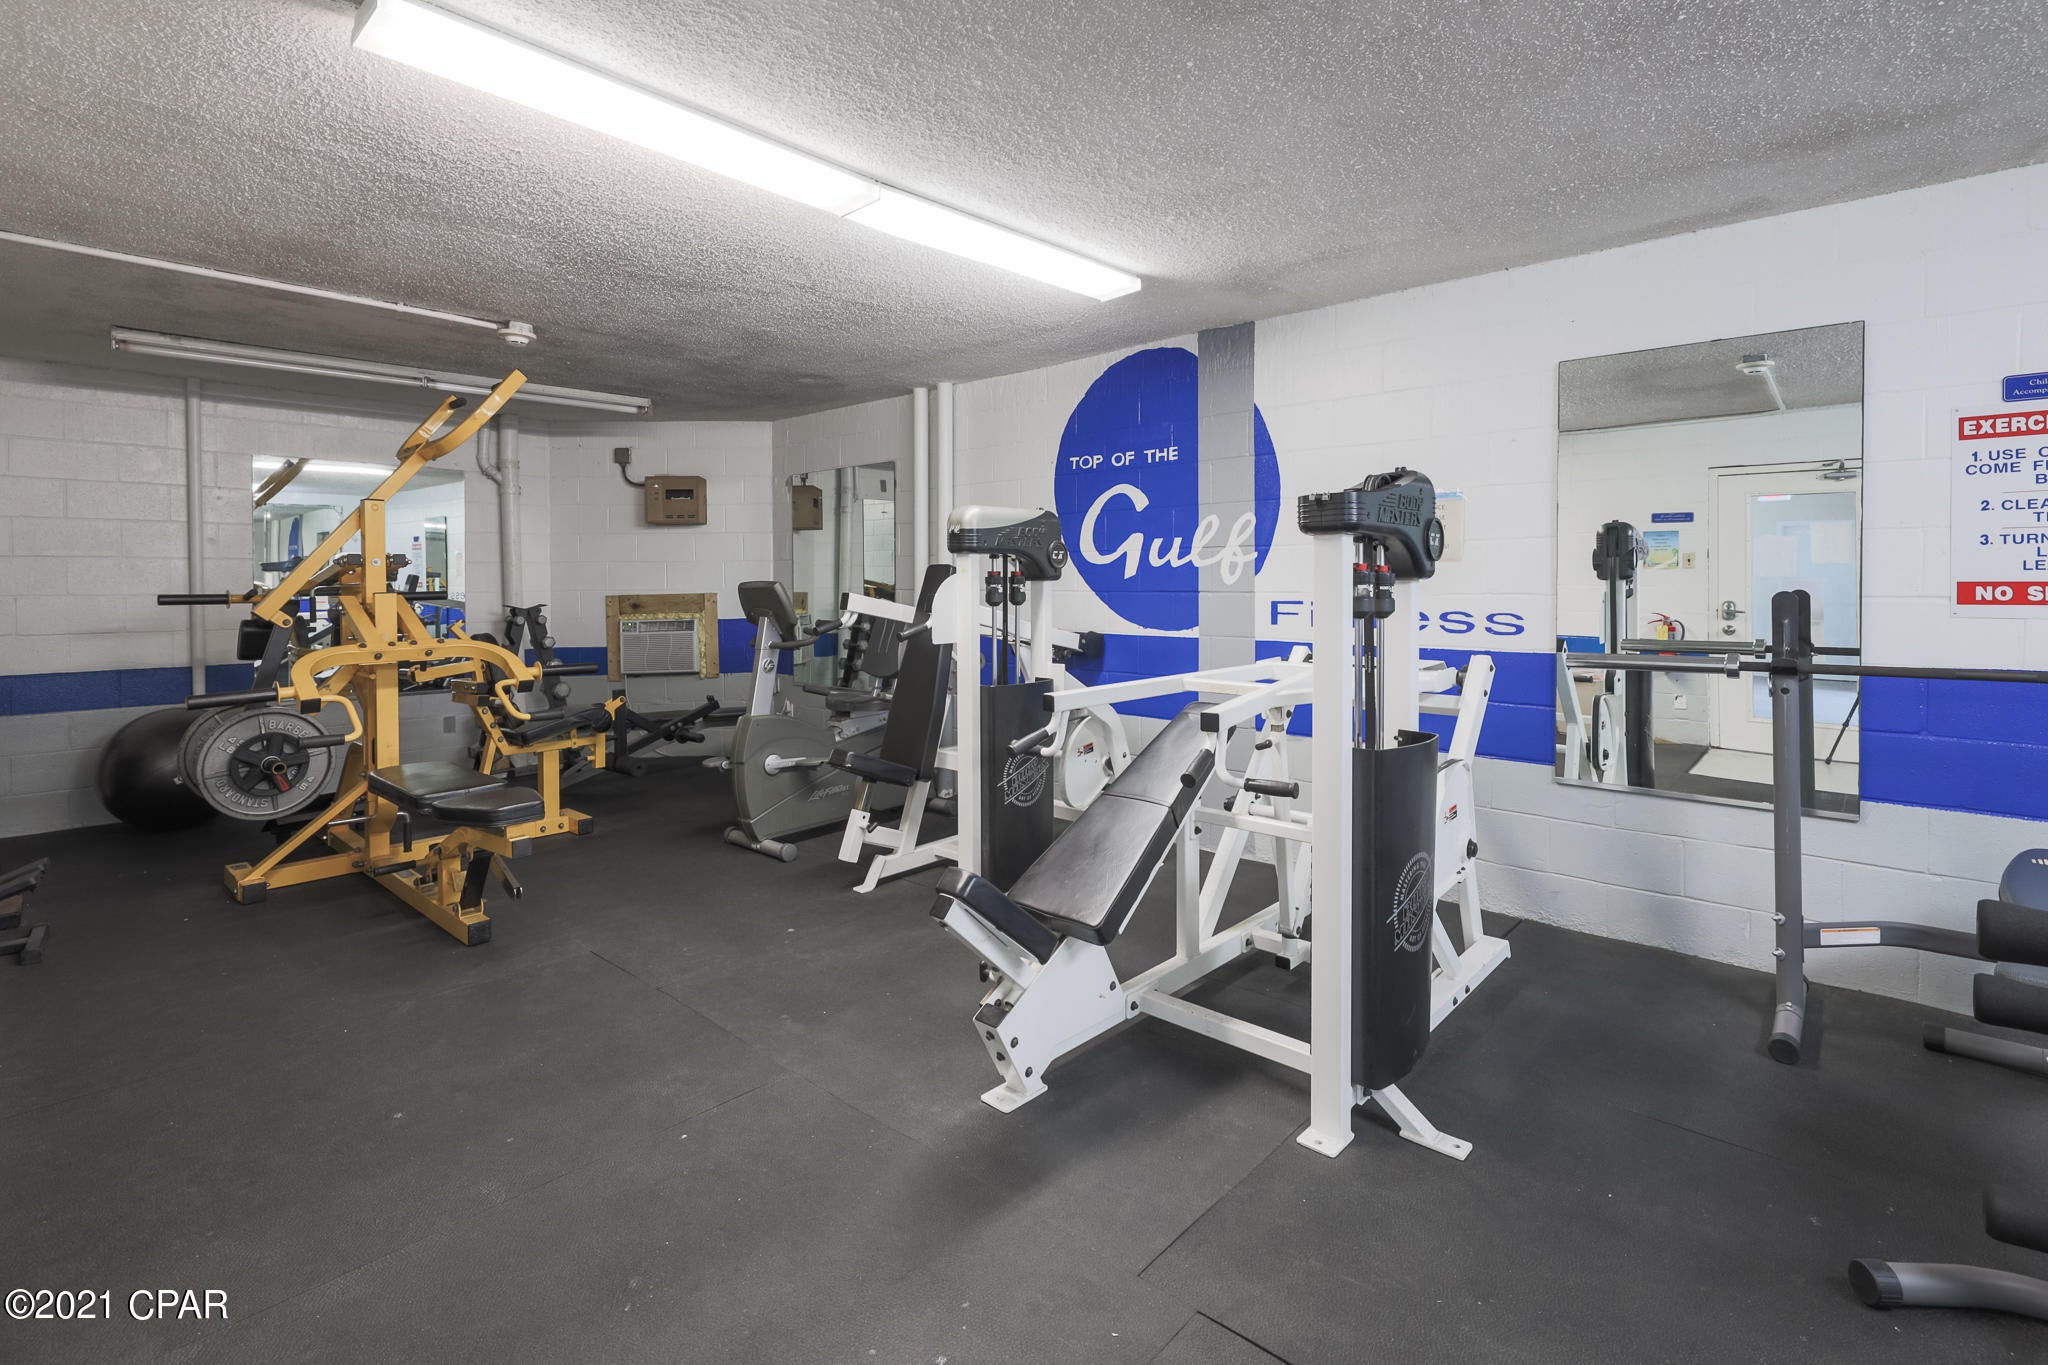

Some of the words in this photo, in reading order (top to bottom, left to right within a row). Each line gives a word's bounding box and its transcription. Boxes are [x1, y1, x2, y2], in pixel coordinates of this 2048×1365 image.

[1963, 414, 2048, 436] EXERC
[1069, 454, 1104, 470] TOP
[1111, 451, 1135, 467] OF
[1143, 446, 1179, 463] THE
[1971, 451, 1982, 462] 1.
[1988, 447, 2027, 461] USE
[1965, 461, 2022, 476] COME
[1980, 499, 1995, 512] 2.
[1078, 483, 1258, 585] Gulf
[1979, 533, 1993, 545] 3.
[2022, 559, 2048, 571] LE
[1975, 585, 2014, 602] NO
[2027, 585, 2048, 602] S
[269, 719, 310, 738] BARBE
